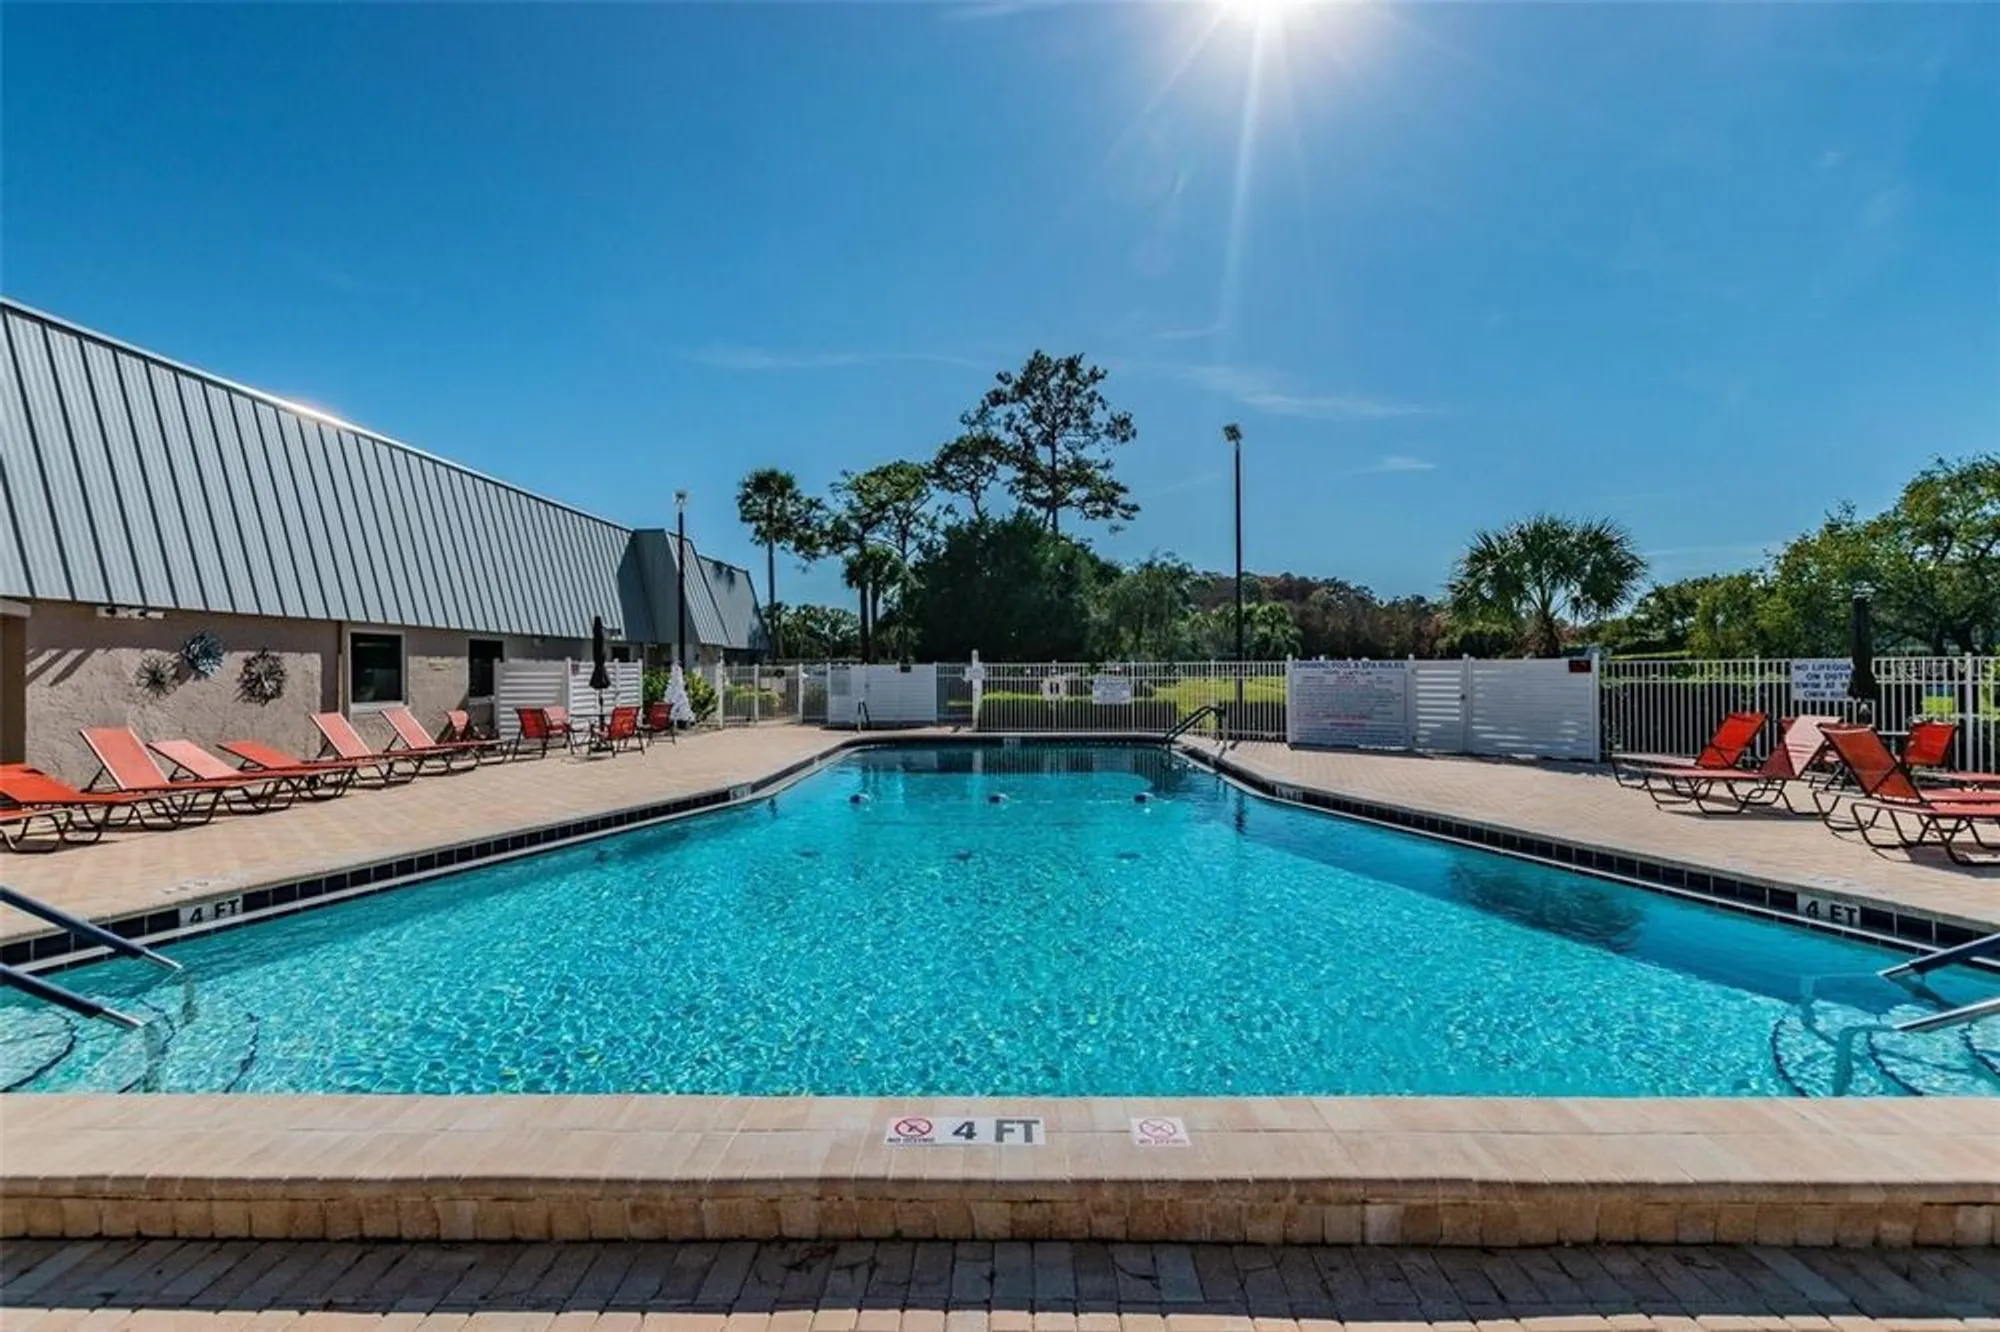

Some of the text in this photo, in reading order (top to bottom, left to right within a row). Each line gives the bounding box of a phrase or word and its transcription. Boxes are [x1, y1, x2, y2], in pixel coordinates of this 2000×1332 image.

[1794, 663, 1852, 671] NO LIFEGUA
[1806, 672, 1850, 681] ON DUTY
[189, 898, 239, 923] 4 FT
[1806, 900, 1857, 926] 4 FT
[952, 1119, 1040, 1143] 4 FT
